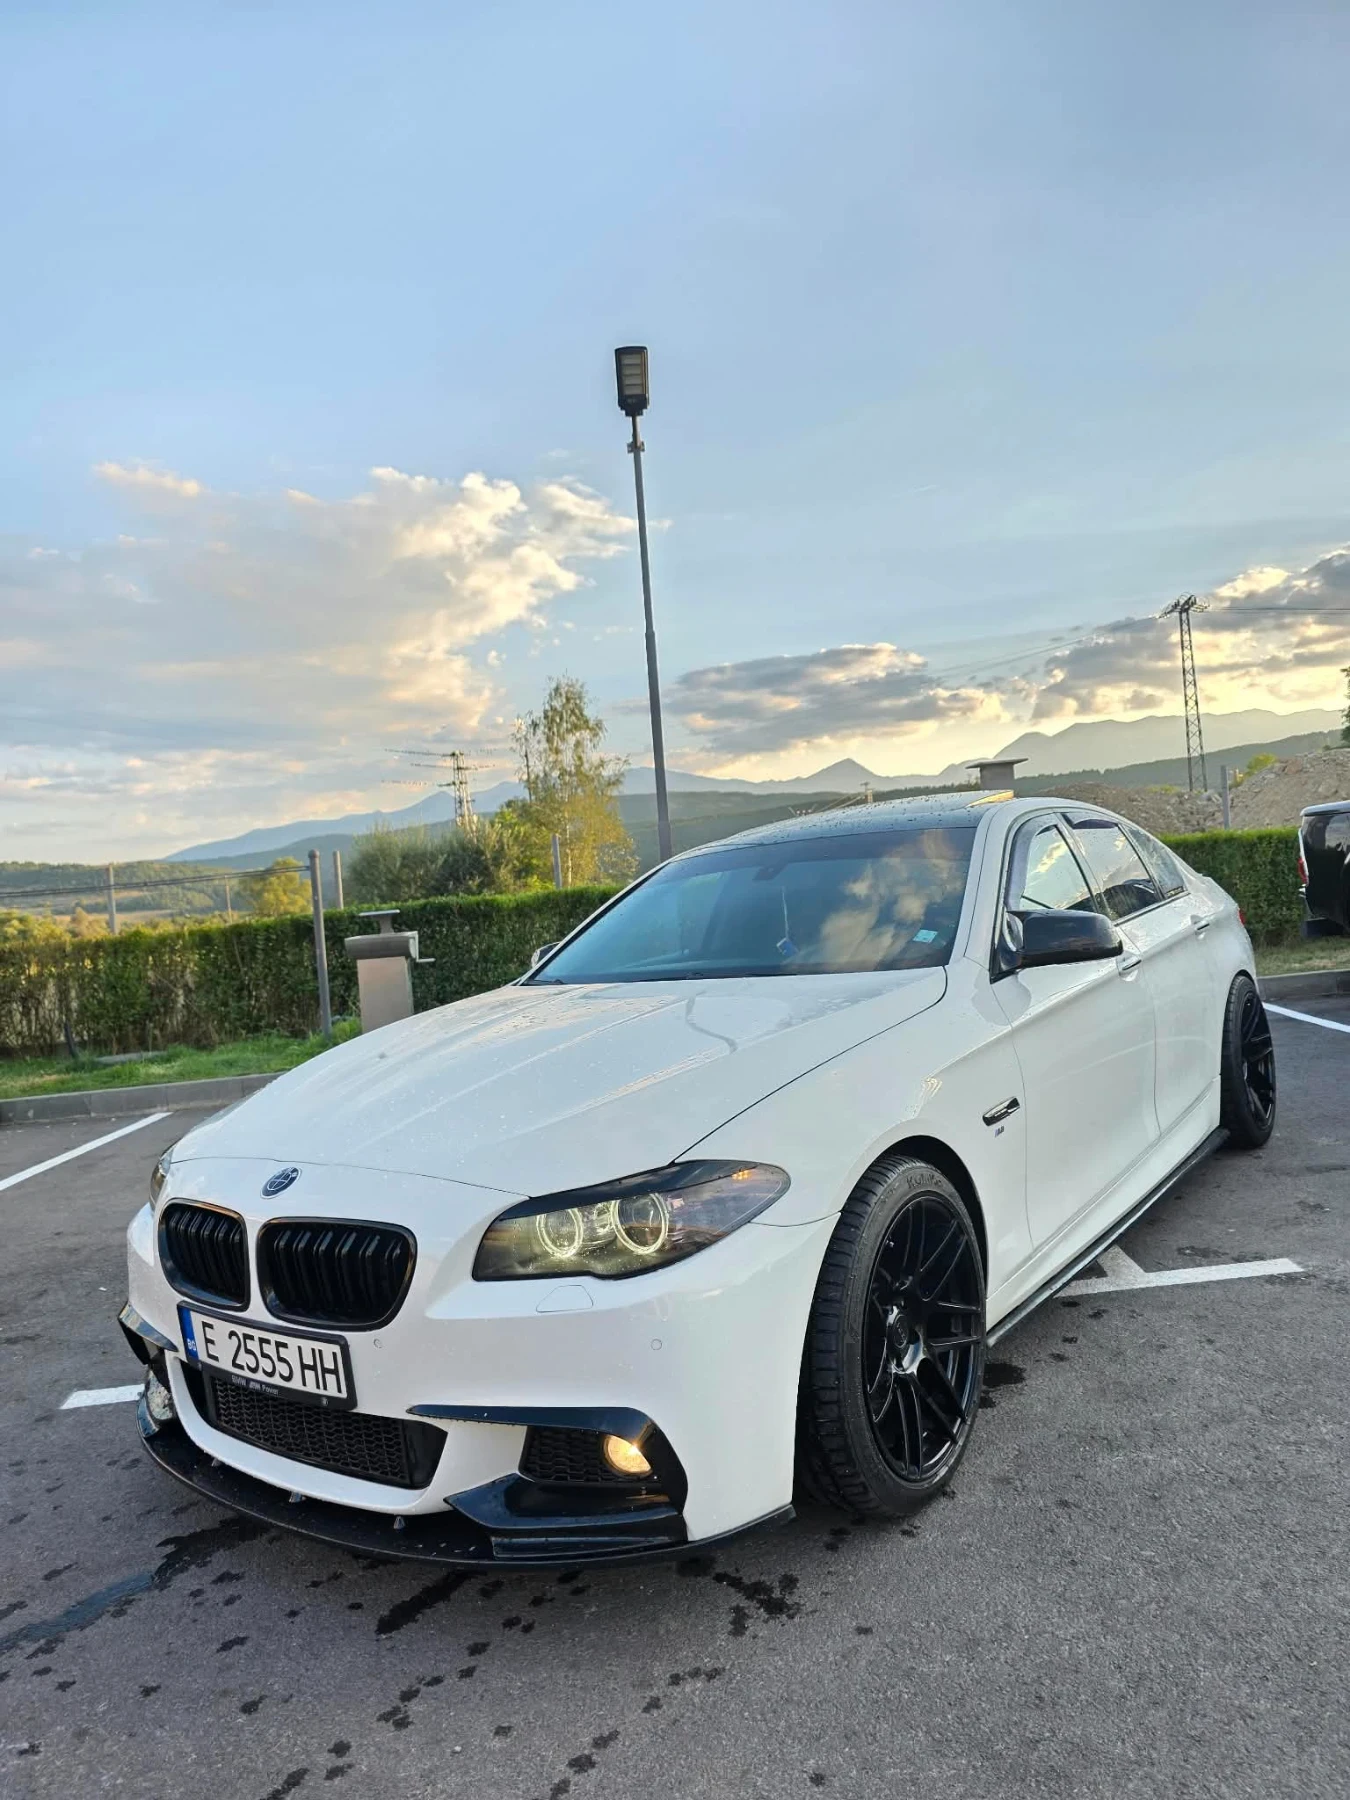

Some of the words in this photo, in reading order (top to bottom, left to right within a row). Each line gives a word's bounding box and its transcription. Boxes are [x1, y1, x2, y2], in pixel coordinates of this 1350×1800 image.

[187, 1338, 197, 1351] BG
[202, 1321, 219, 1362] E
[228, 1330, 293, 1382] 2555
[297, 1345, 342, 1394] HH
